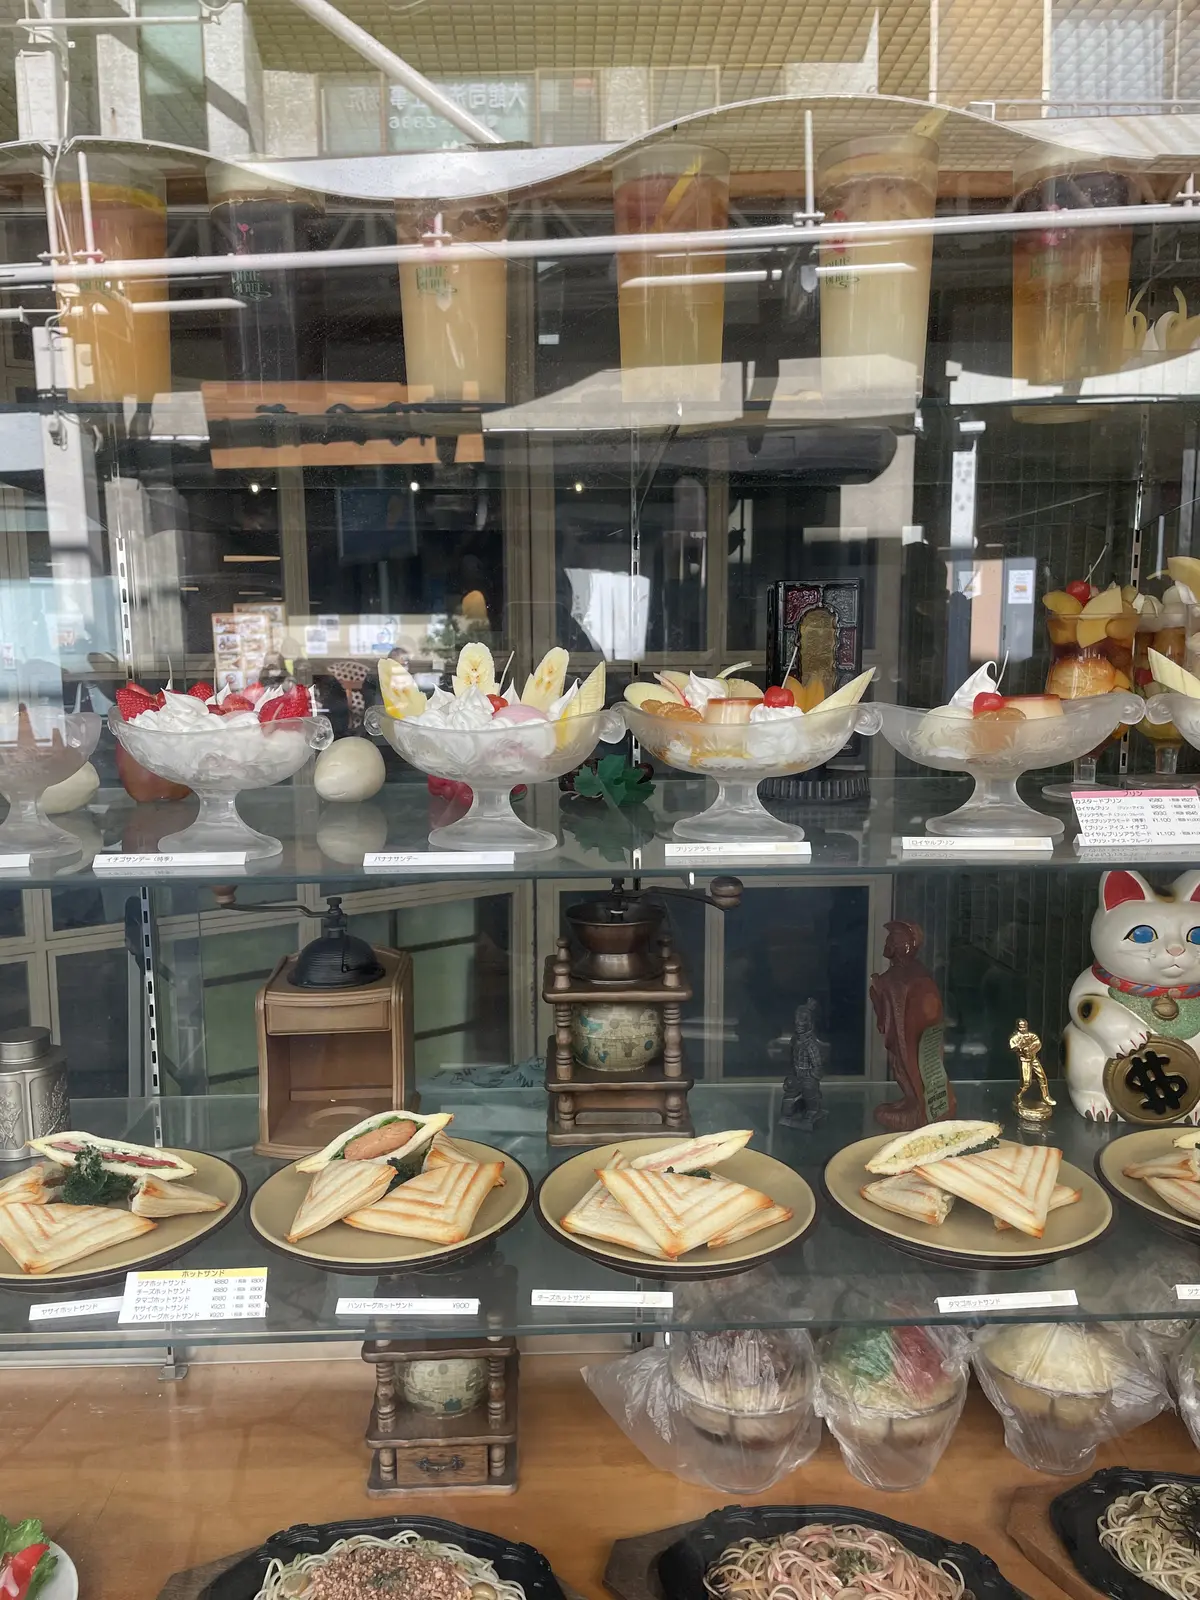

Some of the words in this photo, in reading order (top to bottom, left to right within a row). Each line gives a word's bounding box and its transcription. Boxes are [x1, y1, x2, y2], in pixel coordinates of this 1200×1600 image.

[676, 845, 724, 853] プリンアラモード
[181, 1269, 225, 1278] ホットサンド
[137, 1279, 187, 1288] ツナホットサンド
[136, 1287, 191, 1296] チーズホットサンド
[135, 1295, 190, 1304] タマゴホットサンド
[537, 1294, 591, 1302] チーズホットサンド
[133, 1303, 189, 1312] ヤサイホットサンド
[948, 1298, 1000, 1308] タマゴホットサンド
[41, 1303, 98, 1315] ヤサイホットサンド
[131, 1311, 200, 1321] ハンバーグホットサンド
